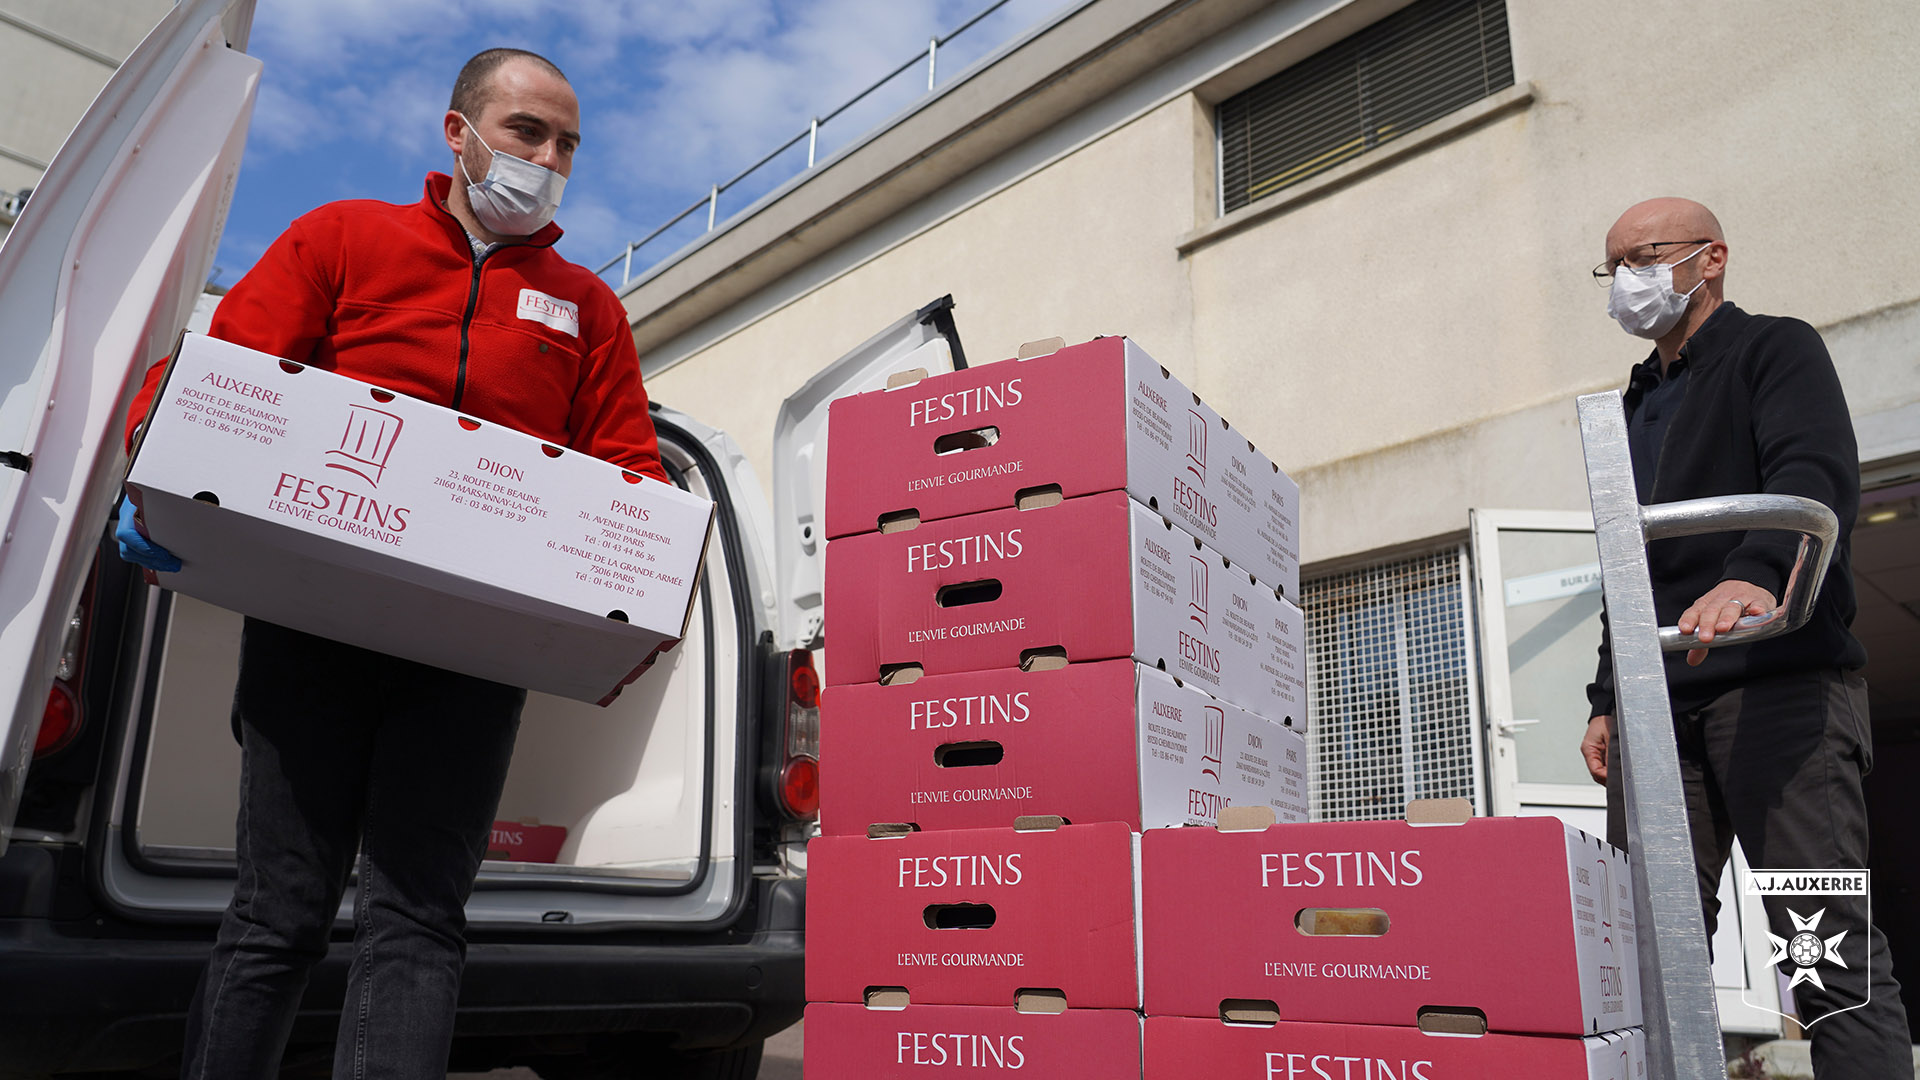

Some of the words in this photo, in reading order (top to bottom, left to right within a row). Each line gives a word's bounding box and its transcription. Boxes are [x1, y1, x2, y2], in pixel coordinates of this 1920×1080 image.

[201, 372, 284, 406] AUXERRE
[910, 378, 1023, 427] FESTINS
[1138, 381, 1168, 412] AUXERRE
[175, 397, 204, 412] 89250
[205, 406, 287, 438] CHEMILLY/YONNE
[182, 387, 216, 404] ROUTE
[217, 398, 231, 409] DE
[233, 402, 289, 426] BEAUMONT
[183, 411, 197, 423] Tél
[204, 419, 216, 428] 03
[218, 422, 230, 433] 86
[232, 426, 245, 436] 47
[246, 431, 257, 441] 94
[259, 435, 273, 446] 00
[477, 457, 524, 482] DIJON
[908, 474, 945, 492] L'ENVIE
[948, 460, 1023, 484] GOURMANDE
[1231, 455, 1247, 477] DIJON
[273, 472, 411, 532] FESTINS
[433, 477, 456, 490] 21160
[457, 484, 548, 519] MARSANNAY-LA-CÔTE
[462, 474, 492, 490] ROUTE
[493, 483, 505, 494] DE
[506, 488, 541, 505] BEAUNE
[1173, 476, 1217, 527] FESTINS
[268, 499, 315, 521] L'ENVIE
[317, 514, 403, 547] GOURMANDE
[450, 493, 463, 504] Tél
[469, 499, 480, 509] 03
[481, 503, 493, 513] 80
[494, 507, 504, 517] 54
[505, 510, 515, 520] 39
[516, 513, 527, 523] 39
[610, 499, 651, 522] PARIS
[592, 515, 625, 532] AVENUE
[626, 525, 672, 545] DAUMESNIL
[600, 528, 622, 541] 75012
[622, 535, 645, 548] PARIS
[584, 534, 596, 545] Tél
[602, 540, 611, 548] 01
[612, 543, 622, 553] 43
[623, 547, 633, 556] 44
[635, 550, 645, 559] 86
[646, 553, 656, 562] 36
[907, 529, 1023, 573] FESTINS
[1144, 537, 1171, 565] AUXERRE
[559, 544, 592, 560] AVENUE
[594, 554, 606, 564] DE
[607, 558, 618, 568] LA
[620, 561, 655, 579] GRANDE
[655, 572, 684, 587] ARMÉE
[590, 565, 611, 577] 75016
[612, 571, 635, 584] PARIS
[1560, 573, 1603, 588] BUREA
[575, 571, 587, 581] Tél
[593, 577, 602, 585] 01
[603, 579, 613, 589] 45
[614, 582, 625, 592] 00
[626, 586, 635, 595] 12
[636, 589, 645, 598] 10
[908, 627, 947, 643] L'ENVIE
[950, 617, 1026, 639] GOURMANDE
[1275, 618, 1289, 635] PARIS
[1179, 630, 1220, 673] FESTINS
[910, 692, 1030, 730] FESTINS
[1152, 701, 1183, 722] AUXERRE
[1247, 733, 1263, 749] DIJON
[911, 790, 950, 804] L'ENVIE
[953, 786, 1033, 802] GOURMANDE
[898, 853, 1023, 887] FESTINS
[1261, 850, 1423, 887] FESTINS
[897, 953, 938, 966] L'ENVIE
[941, 953, 1024, 967] GOURMANDE
[1264, 963, 1317, 977] L'ENVIE
[1321, 963, 1431, 981] GOURMANDE
[897, 1032, 1025, 1070] FESTINS
